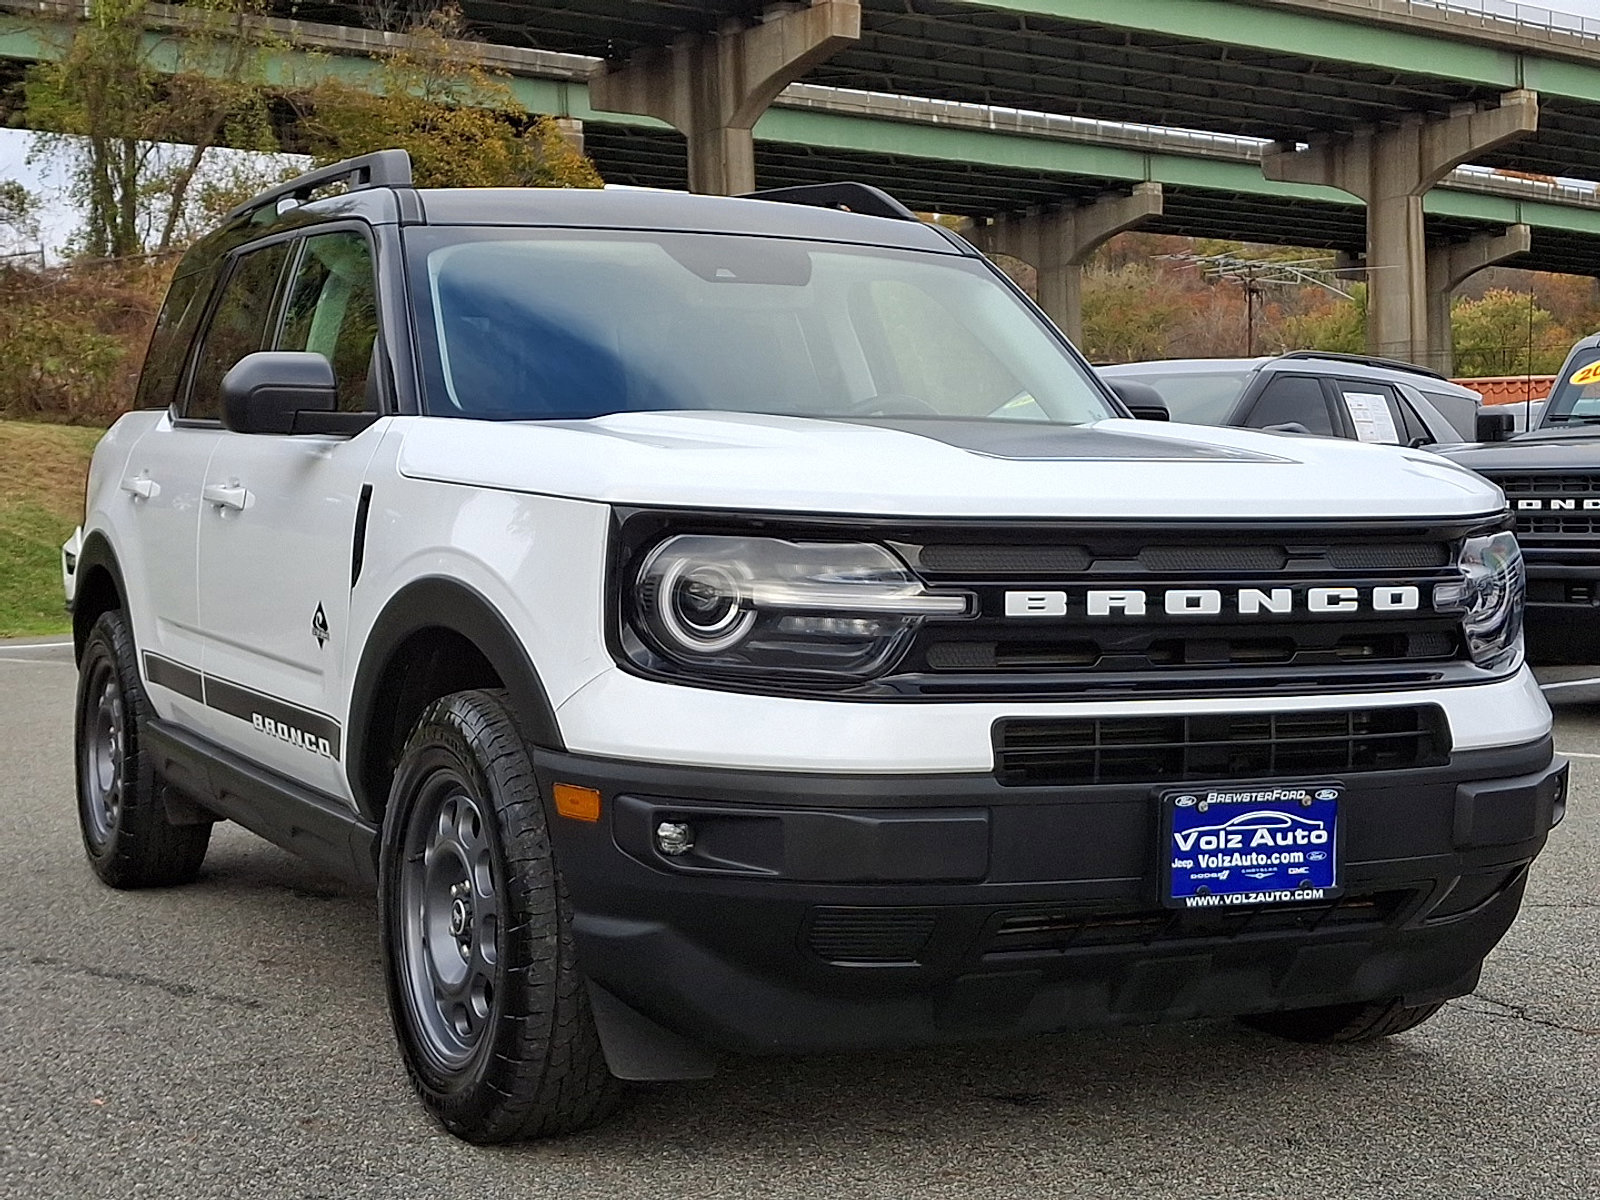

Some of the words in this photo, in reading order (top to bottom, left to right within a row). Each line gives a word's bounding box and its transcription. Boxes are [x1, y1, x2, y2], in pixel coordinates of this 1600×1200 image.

[1505, 499, 1600, 510] ONC
[1005, 586, 1419, 617] BRONCO
[252, 712, 331, 759] BRONCO
[1174, 830, 1243, 851] Volz
[1250, 828, 1328, 847] Auto
[1171, 858, 1194, 869] Jeep
[1198, 851, 1304, 868] VolzAuto.com
[1185, 888, 1324, 907] WWW.VOLZAUTO.COM
